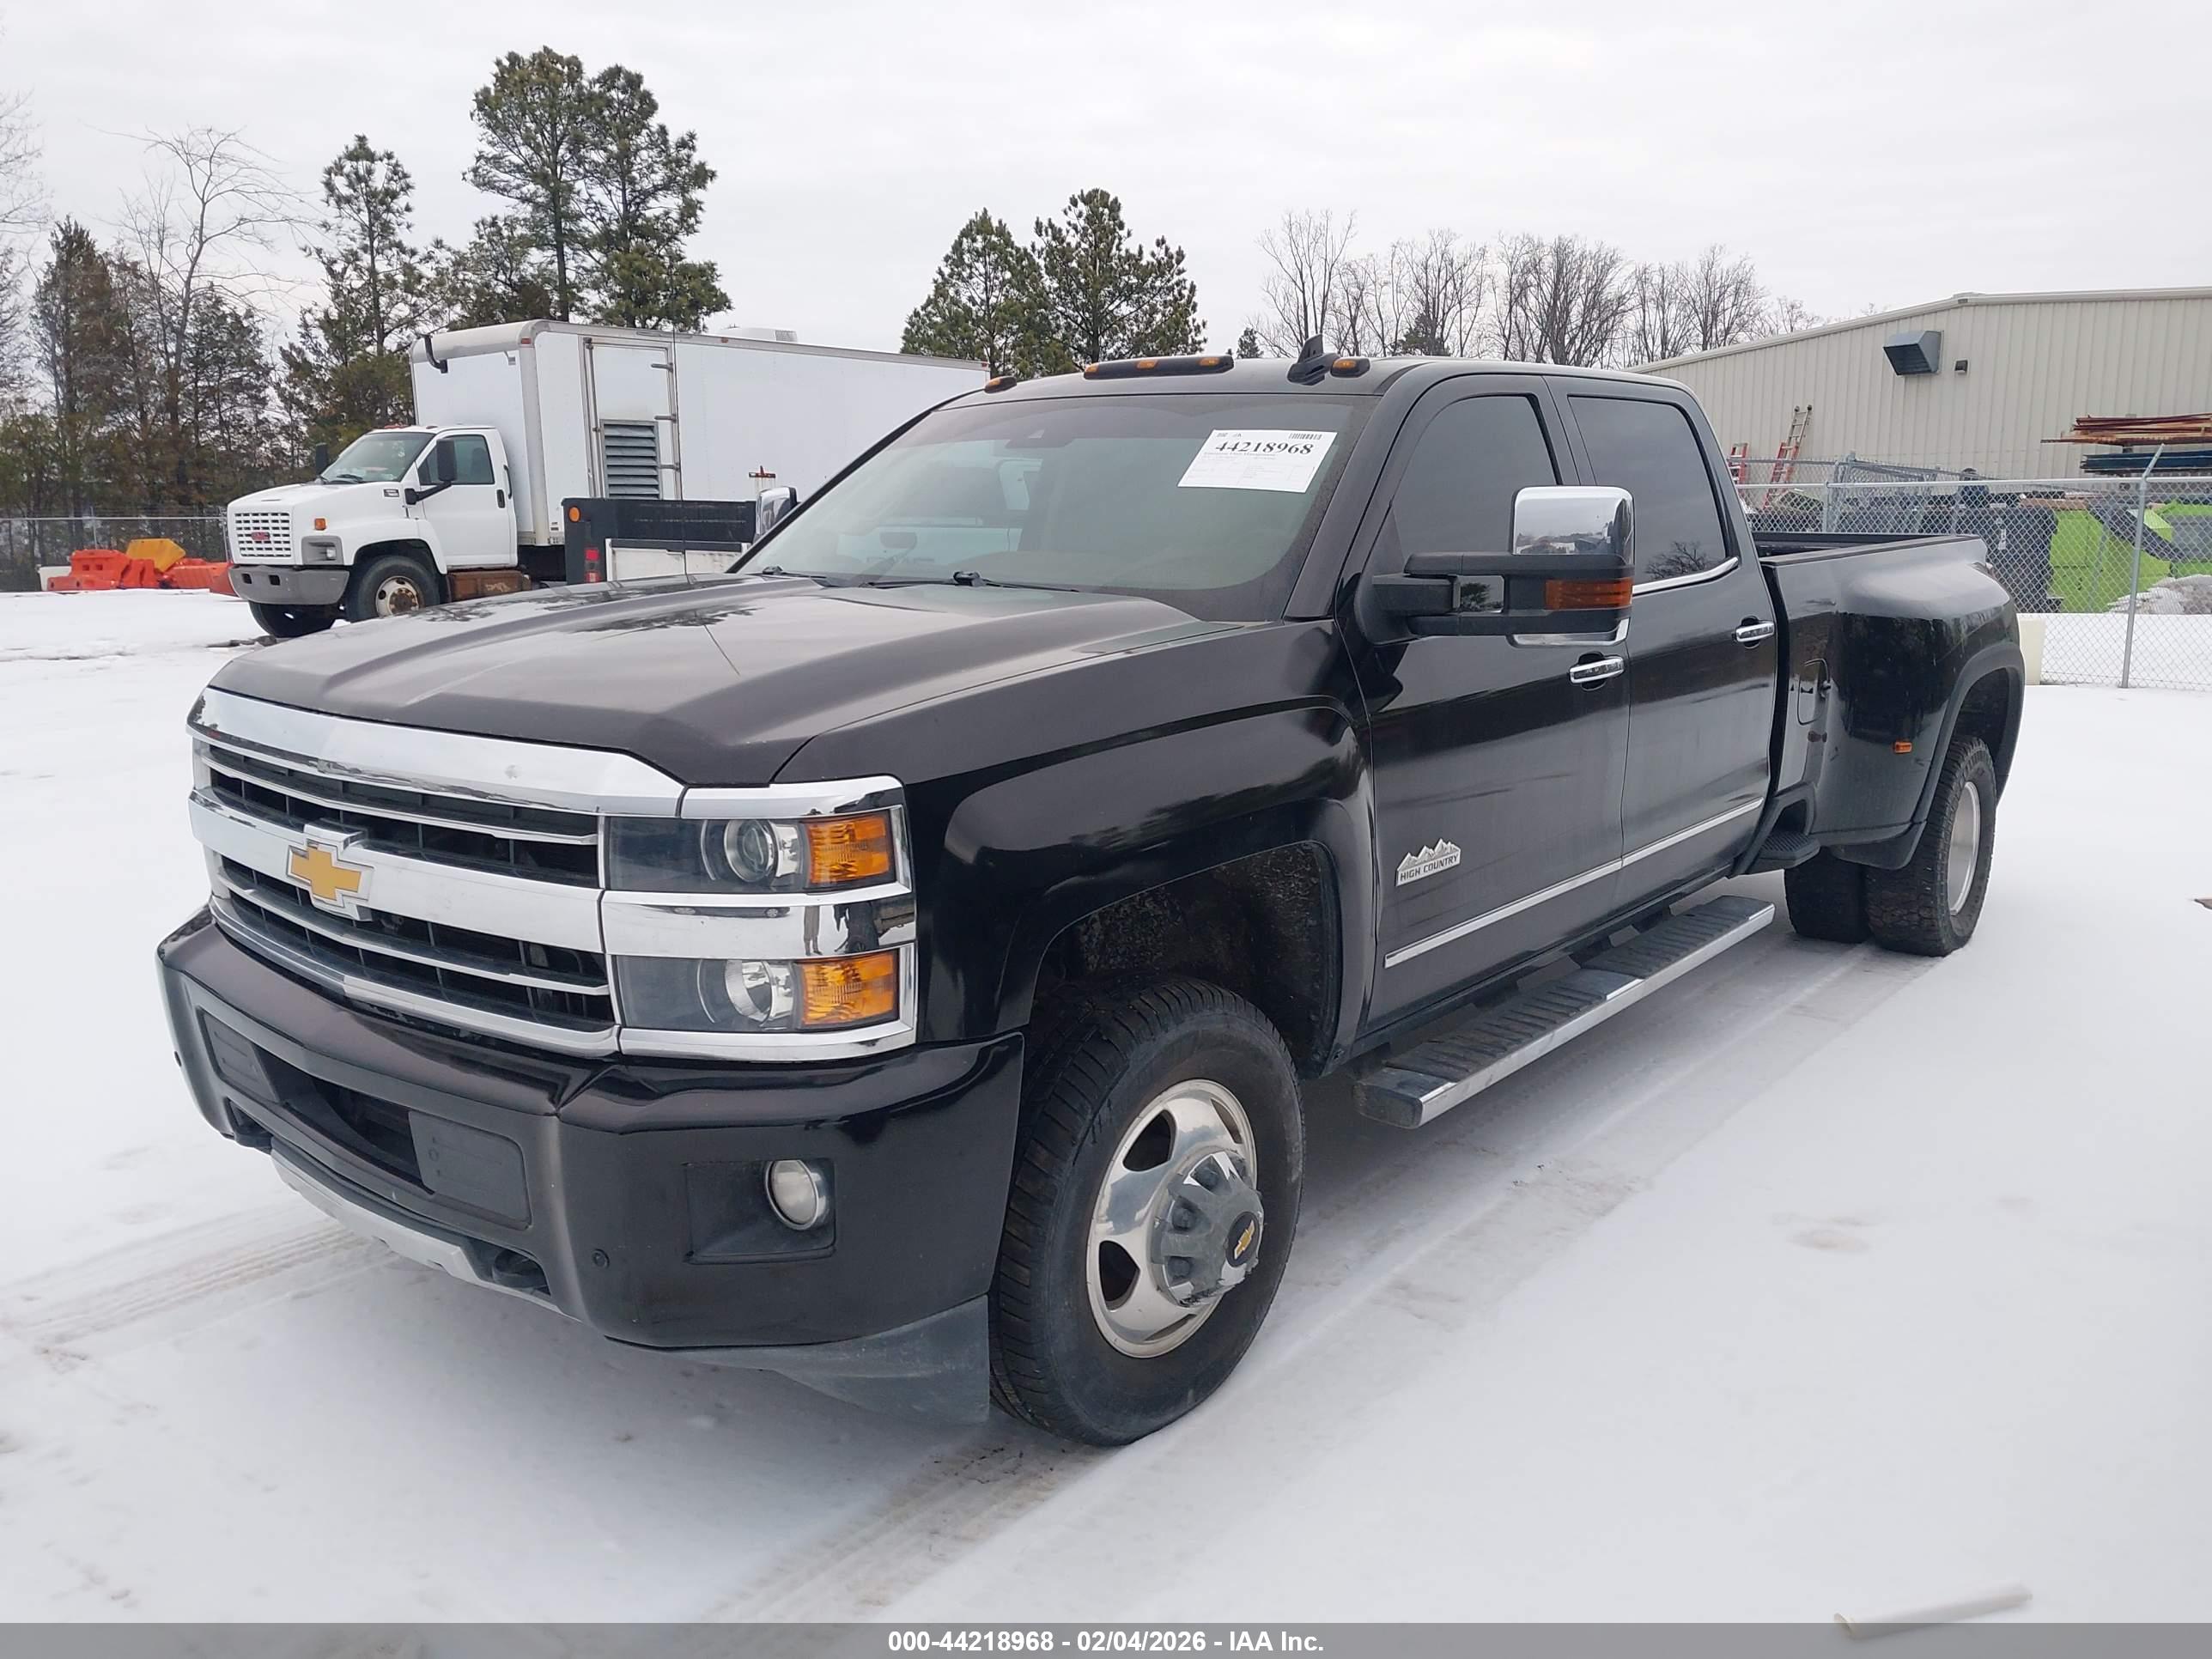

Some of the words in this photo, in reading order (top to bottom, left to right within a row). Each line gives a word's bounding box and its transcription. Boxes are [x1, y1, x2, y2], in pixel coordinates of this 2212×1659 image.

[1215, 441, 1315, 455] 44218968
[1400, 867, 1421, 882] HIGH
[1423, 854, 1459, 873] COUNTRY
